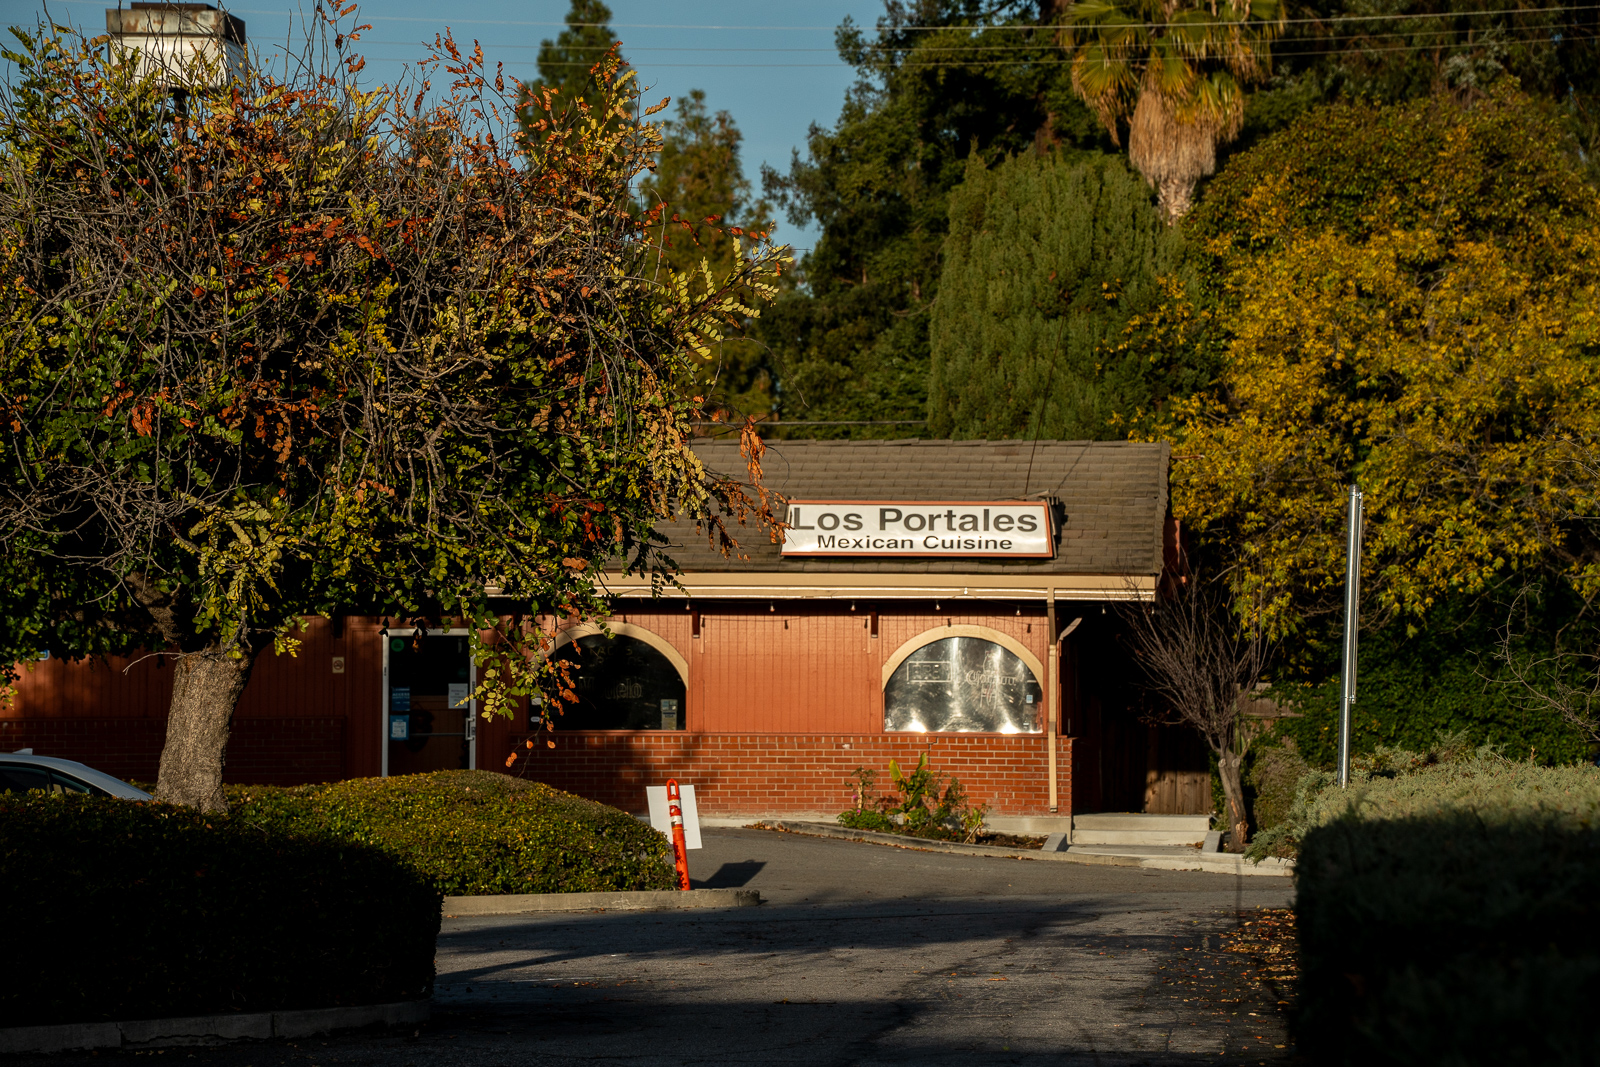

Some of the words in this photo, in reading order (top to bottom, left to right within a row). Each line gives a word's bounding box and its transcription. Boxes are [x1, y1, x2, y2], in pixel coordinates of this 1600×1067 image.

[793, 507, 863, 531] Los
[879, 507, 1038, 532] Portales
[817, 535, 914, 549] Mexican
[923, 535, 1013, 550] Cuisine
[587, 645, 633, 656] TACS
[578, 675, 643, 699] Mdelo
[965, 670, 1016, 687] Corna
